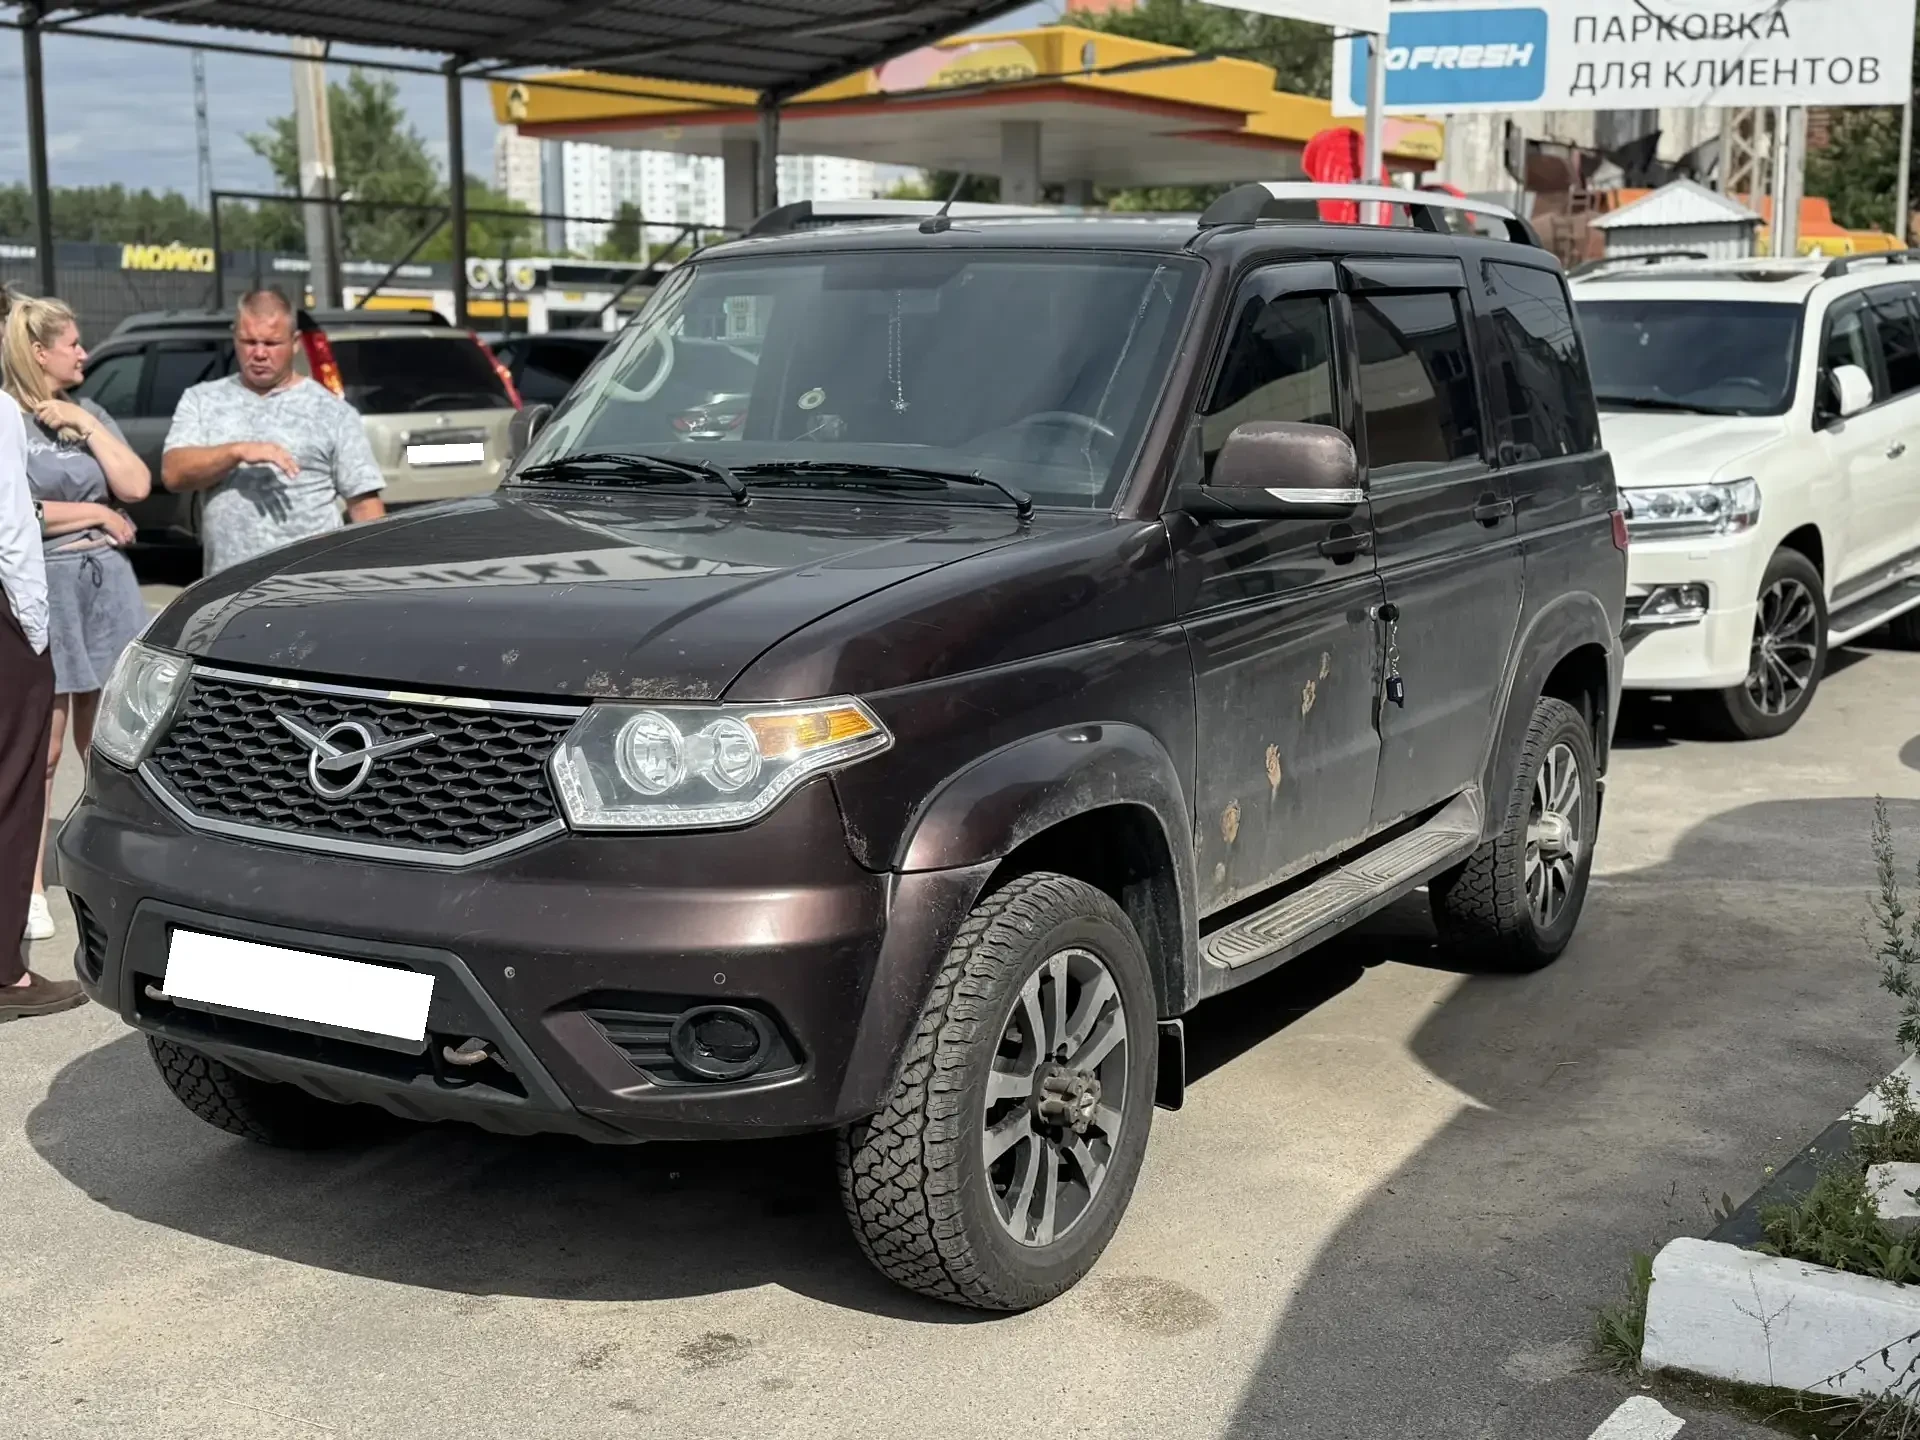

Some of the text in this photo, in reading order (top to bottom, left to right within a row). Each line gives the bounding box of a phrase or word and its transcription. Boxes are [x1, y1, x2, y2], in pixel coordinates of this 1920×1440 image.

[1573, 10, 1790, 44] ПАРКОВКА
[1383, 42, 1535, 71] OFRESH
[1569, 56, 1880, 97] ДЛЯ КЛИЕНТОВ
